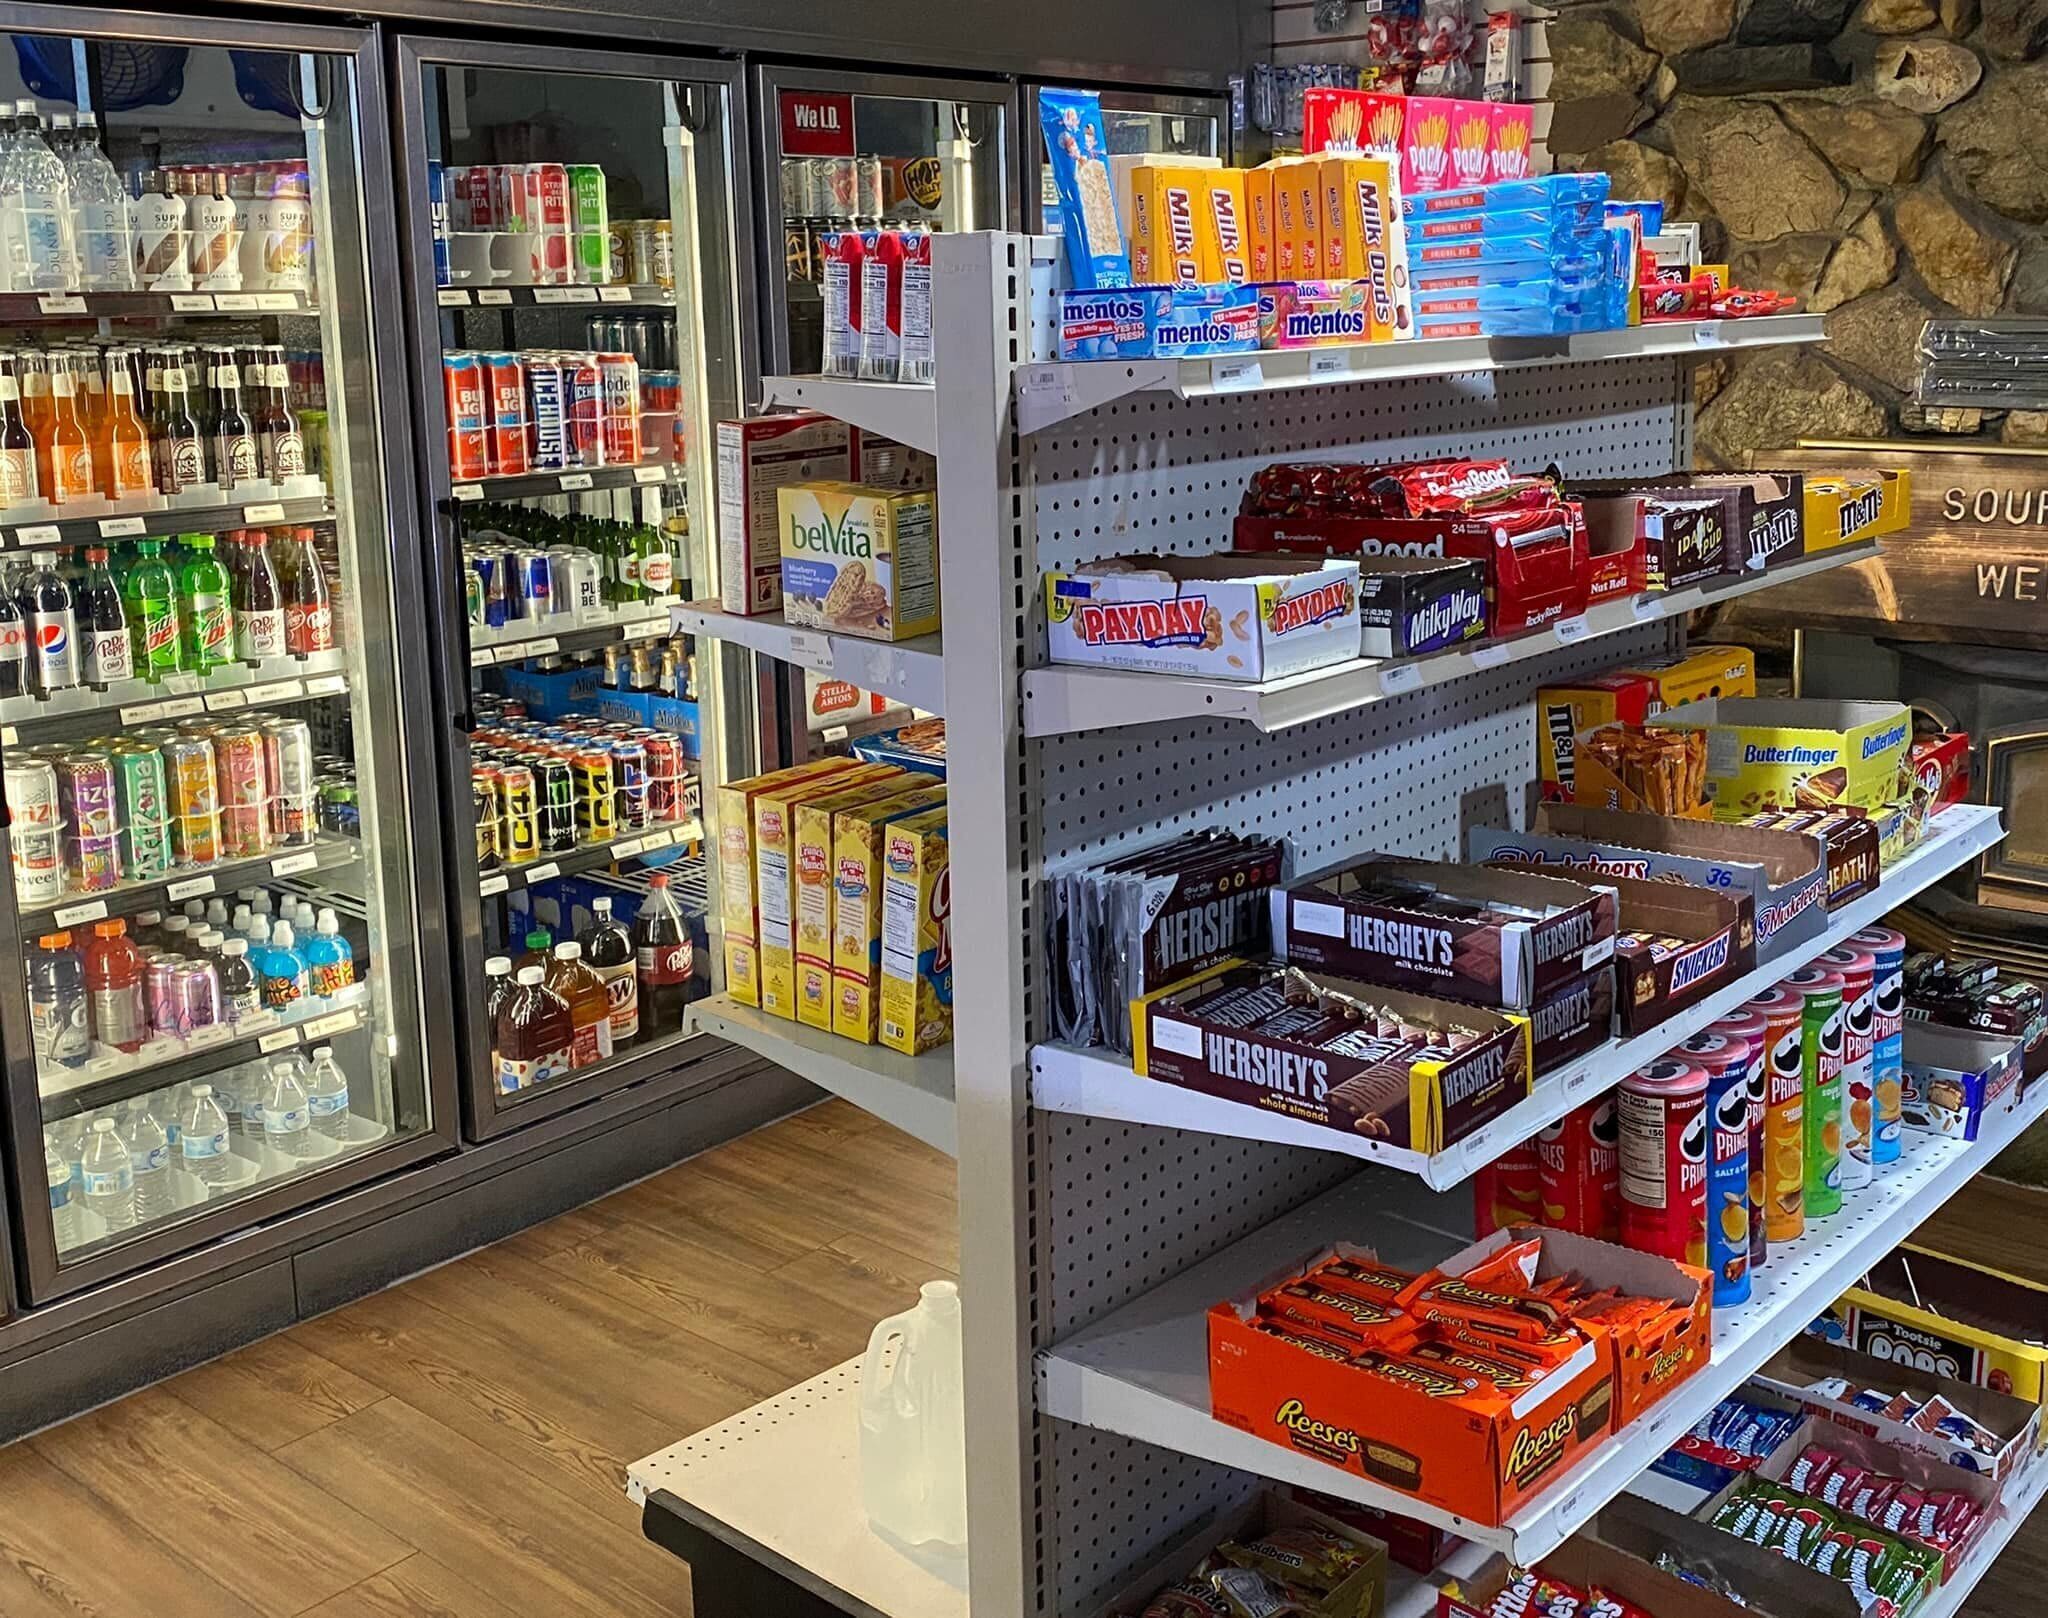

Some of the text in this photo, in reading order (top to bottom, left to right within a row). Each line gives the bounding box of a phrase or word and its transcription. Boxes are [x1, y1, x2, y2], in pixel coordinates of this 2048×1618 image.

[794, 104, 818, 127] We
[1168, 190, 1193, 252] Milk
[1212, 190, 1240, 252] Milk
[1360, 183, 1390, 322] Milk Duds
[1064, 297, 1144, 321] mentos
[1158, 322, 1231, 345] mentos
[1289, 308, 1363, 336] mentos
[1115, 331, 1146, 343] FRESH
[461, 390, 485, 401] BU
[501, 387, 524, 399] BU
[533, 370, 562, 467] ICEHOUSE
[791, 509, 872, 559] belVita
[1452, 524, 1465, 534] 24
[788, 564, 817, 576] blueberry
[1591, 577, 1628, 595] Nut Roll
[1276, 580, 1345, 634] PAYDAY
[1082, 599, 1206, 643] PAYDAY
[821, 684, 852, 699] STELLA
[821, 694, 852, 708] ARTOIS
[1862, 722, 1907, 759] Butterfinger
[1744, 744, 1839, 767] Butterfinger
[800, 843, 825, 858] Crunch
[890, 837, 914, 851] Crunch
[802, 858, 825, 871] Munch
[839, 856, 864, 872] Crunch
[893, 850, 914, 862] Munch
[841, 871, 865, 885] Munch
[1706, 868, 1733, 887] 36
[1769, 878, 1825, 935] Musketeers
[1350, 912, 1453, 966] HERSHEY'S
[1535, 911, 1593, 965] HERSHEY'S
[1395, 959, 1453, 978] milk chocolate
[1672, 933, 1729, 991] SNICKERS
[1532, 988, 1591, 1043] HERSHEY'S
[1969, 1013, 1992, 1028] 36
[1208, 1033, 1329, 1102] HERSHEY'S
[1445, 1044, 1504, 1107] HERSHEY'S
[1259, 1095, 1329, 1123] whole almonds
[1271, 1093, 1285, 1102] milk
[1286, 1095, 1315, 1109] chocolate
[1649, 1129, 1664, 1138] 150
[1715, 1167, 1734, 1178] SALT
[1893, 1324, 1942, 1350] Tootsie
